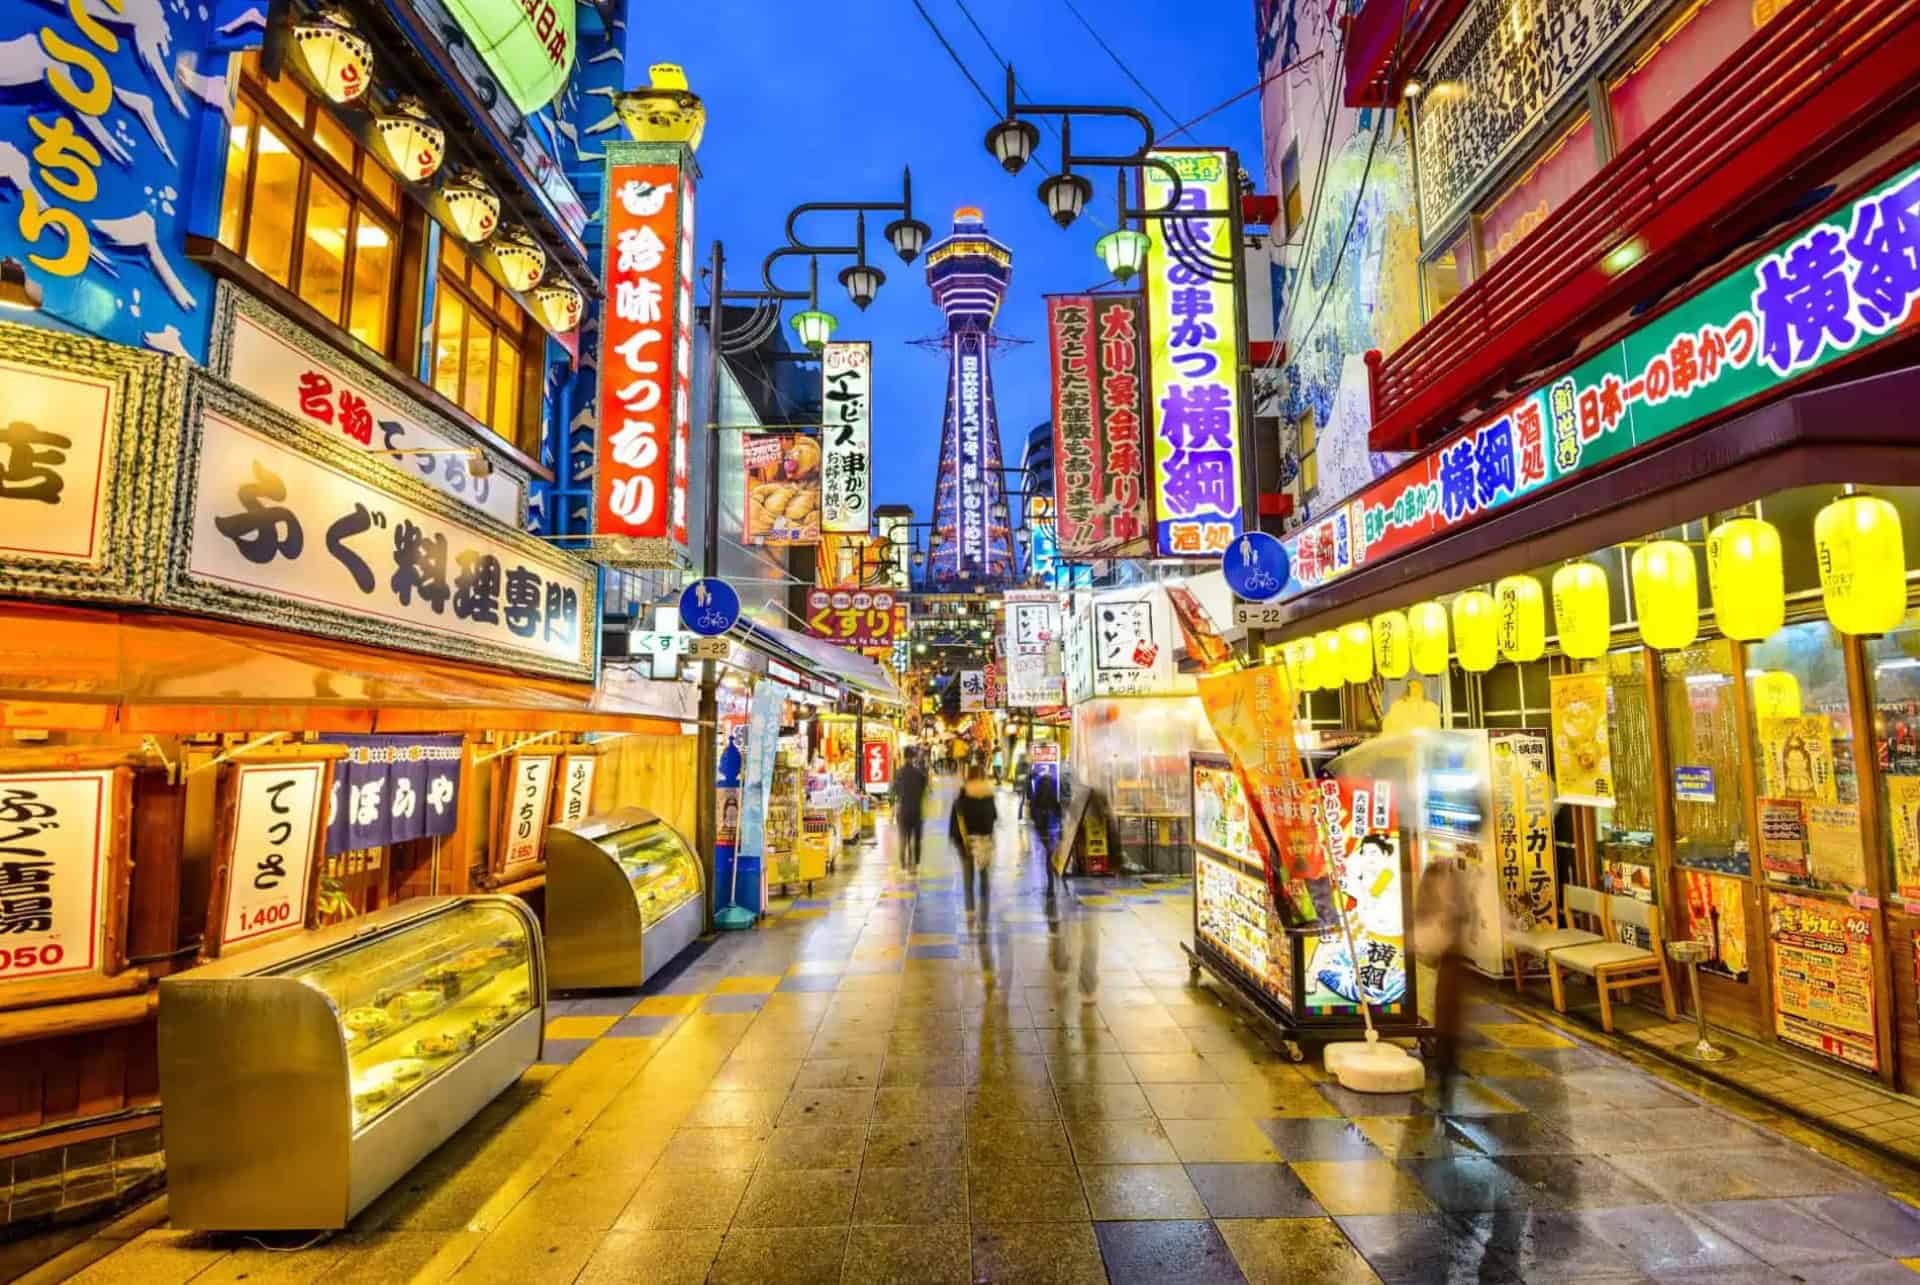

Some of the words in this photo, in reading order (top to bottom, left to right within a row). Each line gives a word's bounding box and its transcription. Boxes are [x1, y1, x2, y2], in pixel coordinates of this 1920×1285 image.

[1150, 158, 1221, 181] 世界
[608, 226, 666, 526] 珍味てっちり
[1579, 318, 1753, 440] 日本一の串かつ
[1160, 385, 1233, 514] 横綱
[1441, 420, 1515, 520] 横綱
[214, 458, 579, 643] ふぐ料理専門
[1173, 524, 1231, 550] 酒処
[811, 608, 890, 637] くすり
[254, 780, 297, 890] てっさ
[518, 764, 540, 839] てっちり
